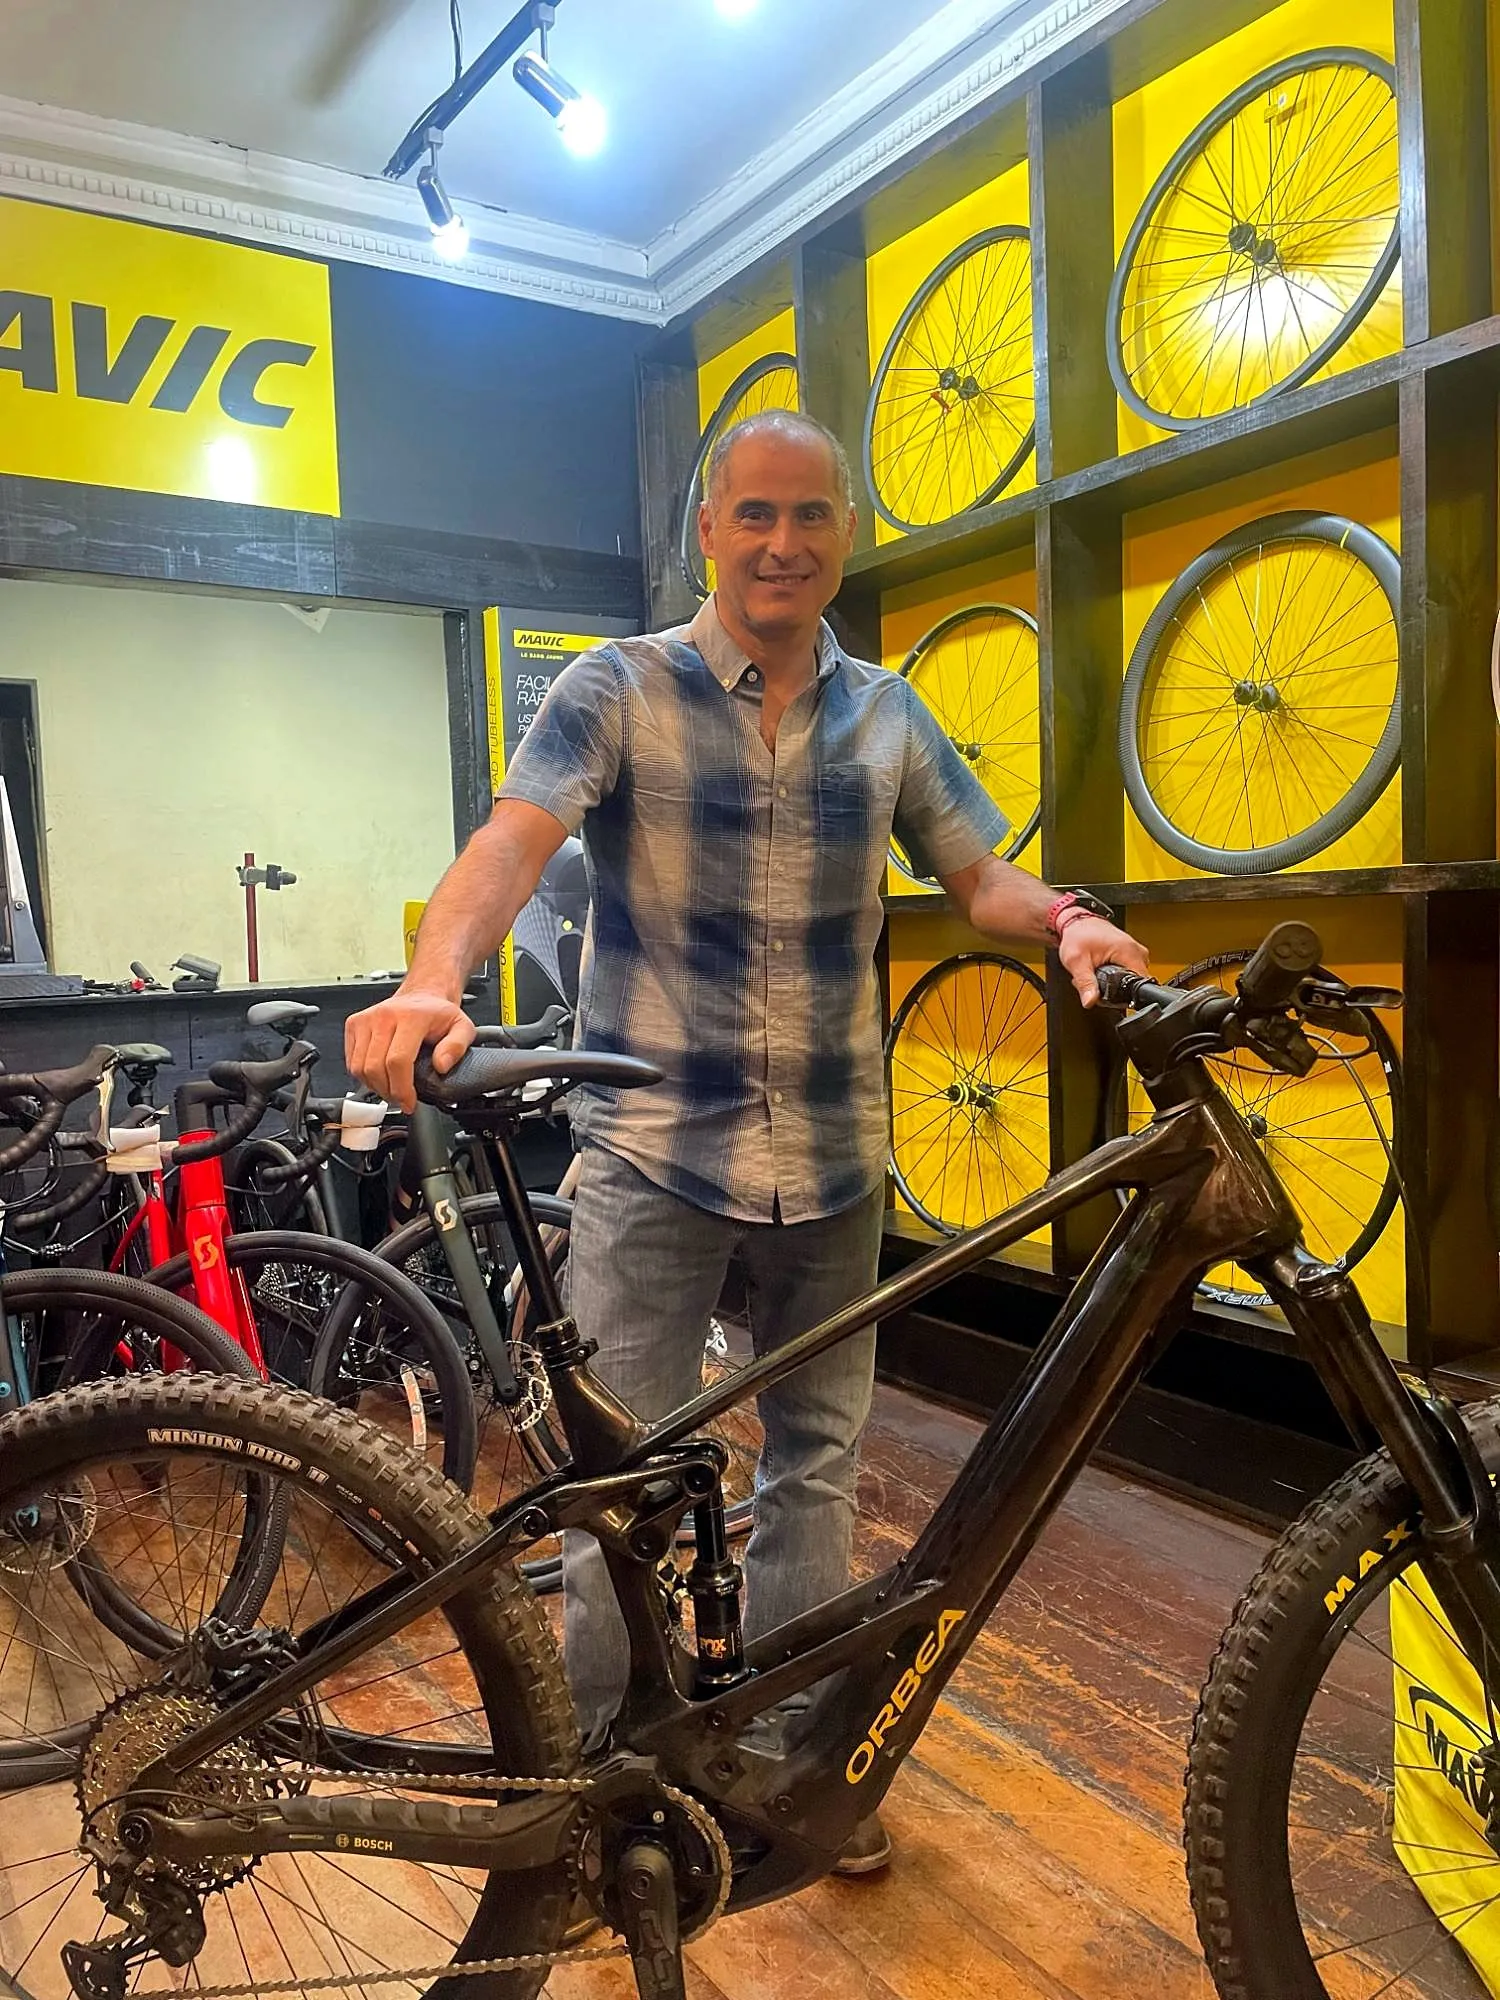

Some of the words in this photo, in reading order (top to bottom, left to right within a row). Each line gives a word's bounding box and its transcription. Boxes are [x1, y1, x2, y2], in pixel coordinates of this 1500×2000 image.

[518, 634, 565, 647] MAVIC
[488, 675, 498, 757] TUBELESS
[148, 1428, 242, 1452] MINION
[1323, 1512, 1420, 1616] MAX
[846, 1609, 967, 1785] ORBEA
[354, 1837, 393, 1851] BOSCH
